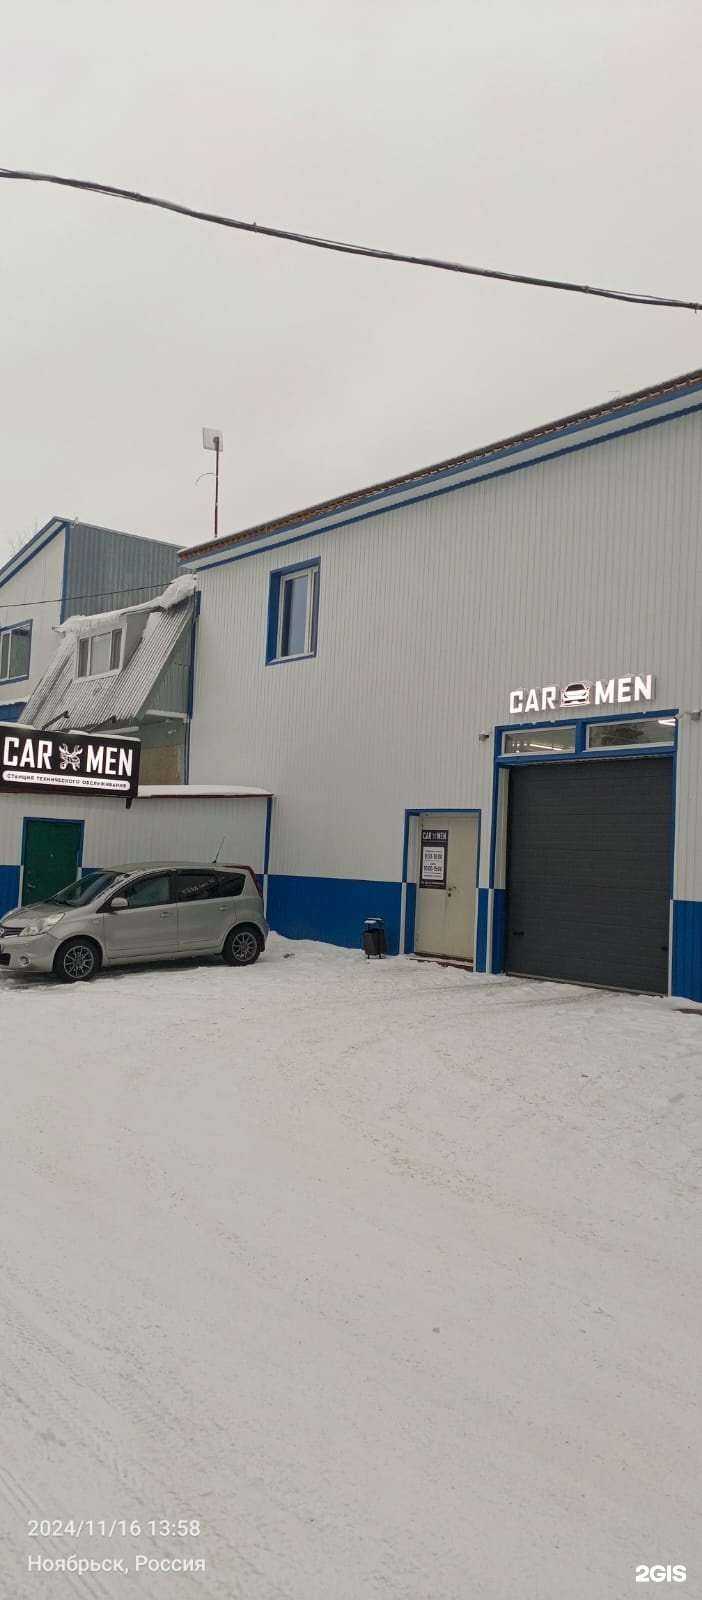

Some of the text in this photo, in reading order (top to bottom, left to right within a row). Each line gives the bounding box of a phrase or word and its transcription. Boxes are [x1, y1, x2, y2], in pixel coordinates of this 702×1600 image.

[509, 674, 652, 714] CAR MEN
[3, 736, 133, 777] CAR MEN
